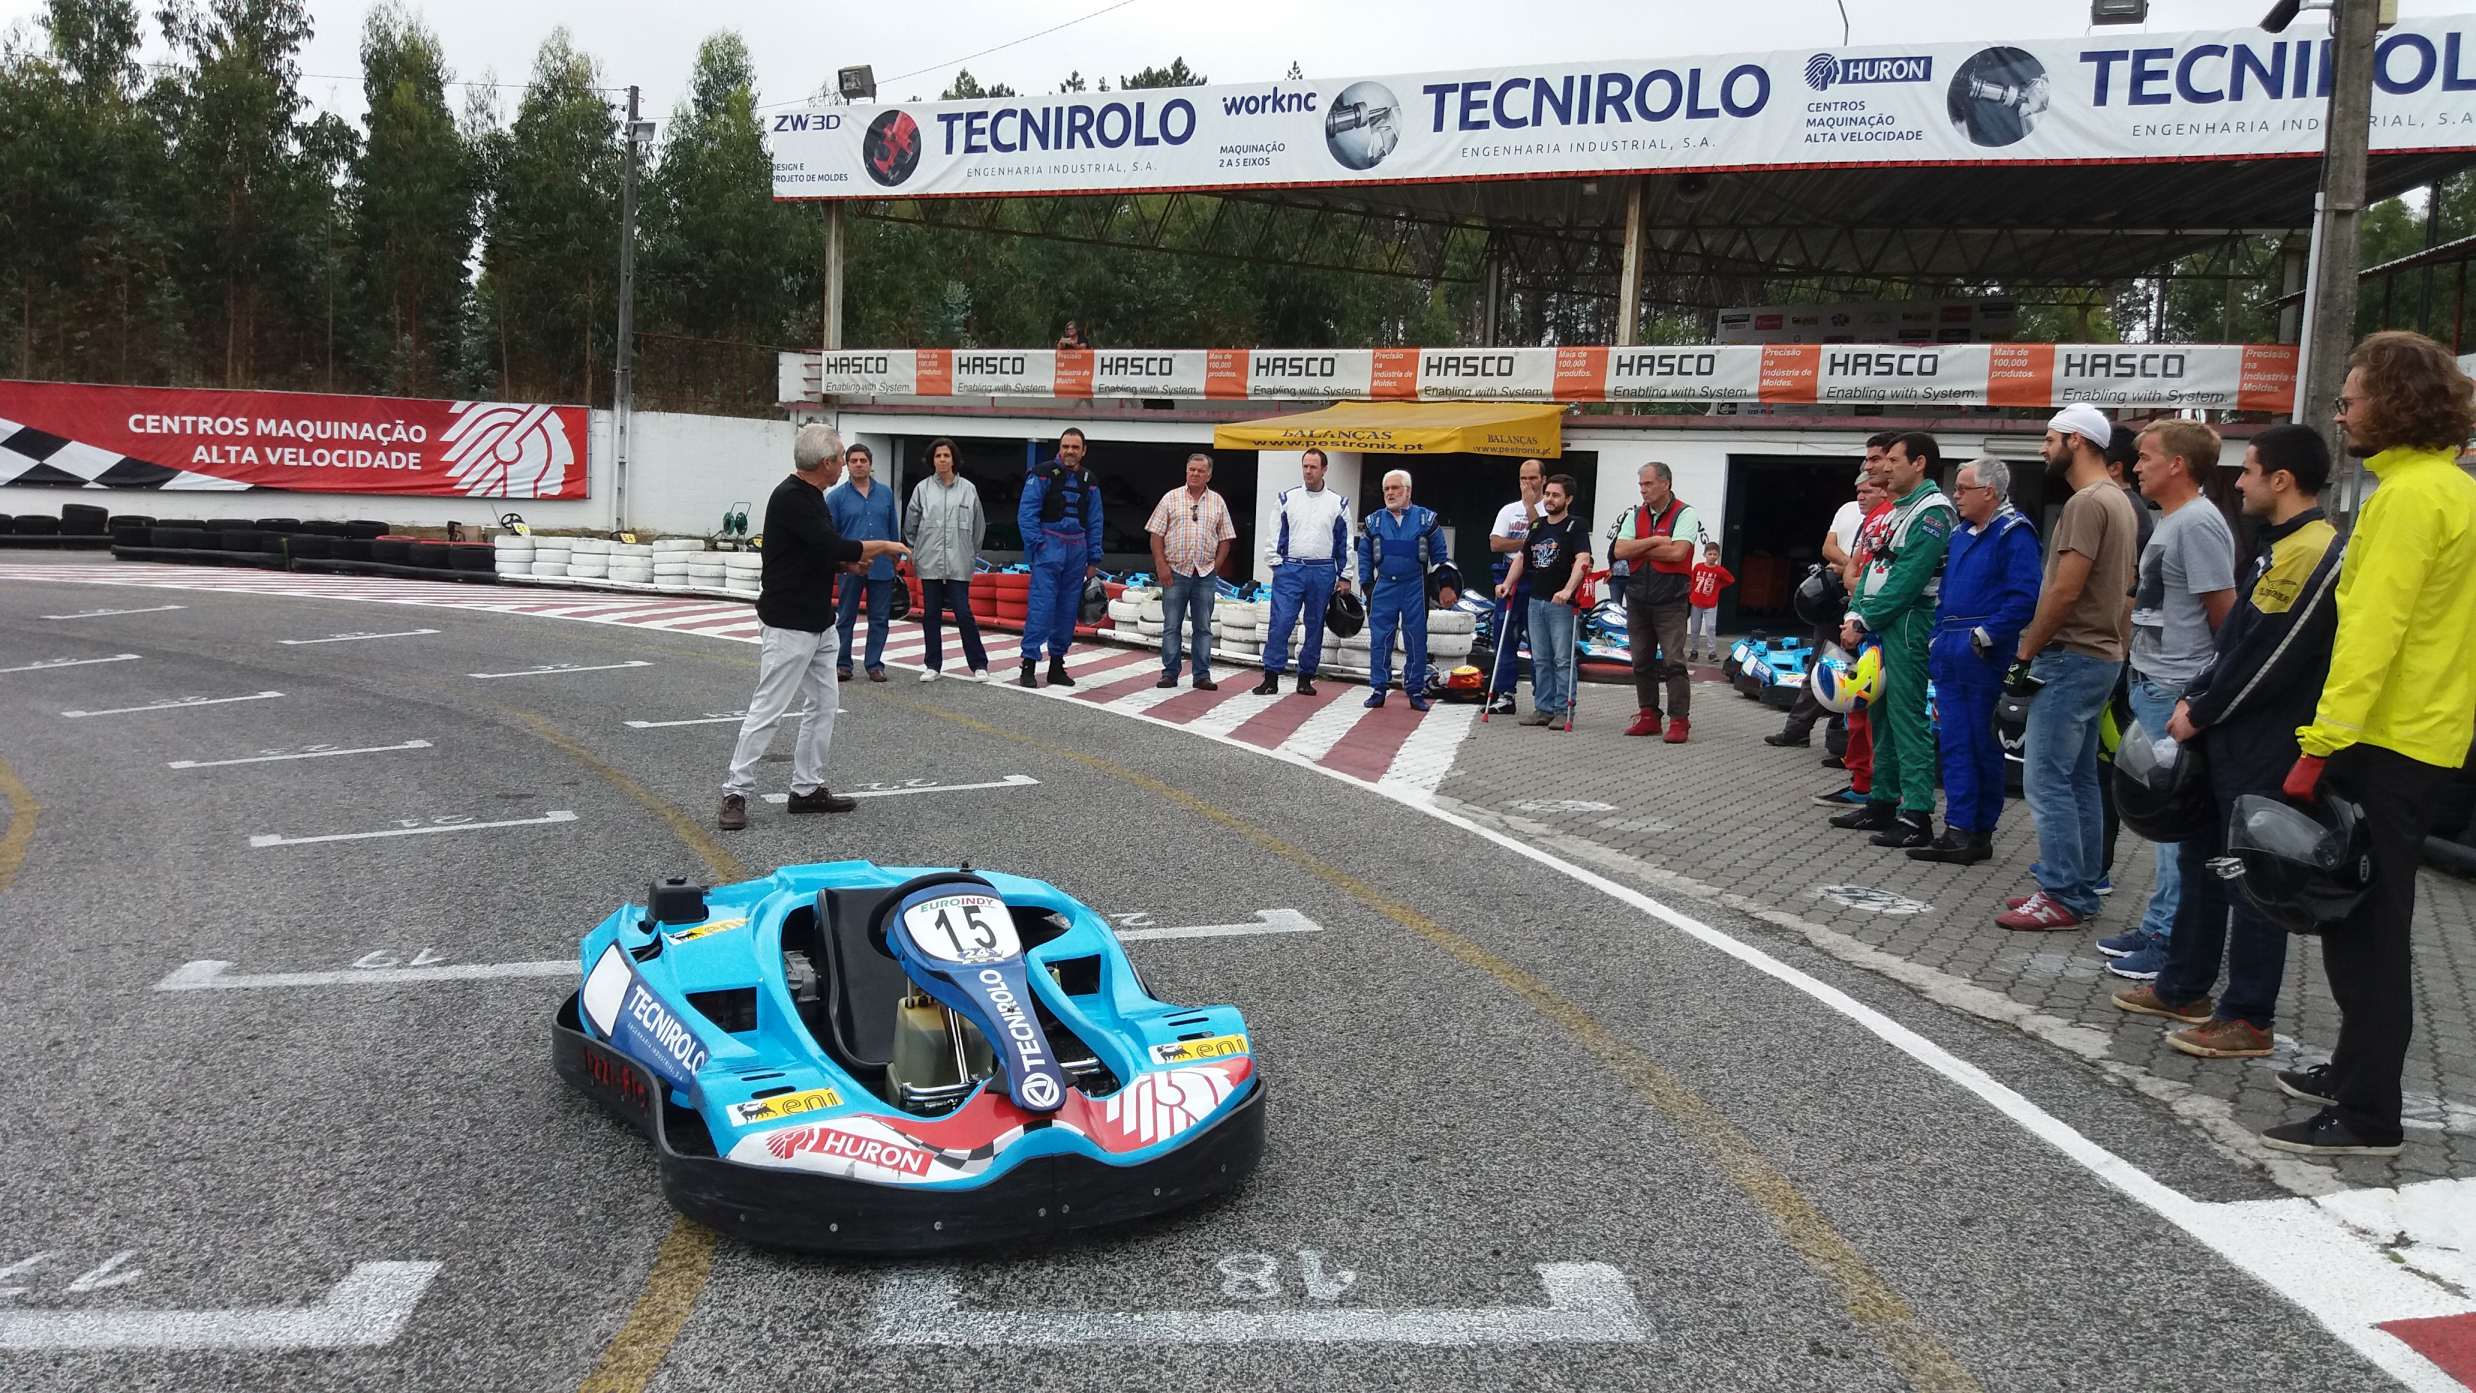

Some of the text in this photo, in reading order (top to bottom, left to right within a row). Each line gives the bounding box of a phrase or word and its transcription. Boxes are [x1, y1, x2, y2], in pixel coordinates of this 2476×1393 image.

[1849, 60, 1924, 81] HURON
[2079, 32, 2476, 107] TECNIOL
[1223, 87, 1317, 116] worknc
[1423, 64, 1771, 133] TECNIROLO
[1807, 101, 1866, 112] CENTROS
[774, 114, 841, 132] ZW3D
[937, 98, 1196, 155] TECNIROLO
[1806, 113, 1895, 129] MAQUINAÇÃO
[2131, 120, 2270, 137] ENGENHARIA
[1804, 130, 1923, 143] ALTA VELOCIDADE
[1219, 142, 1285, 155] MAQUINAÇÃO
[1461, 136, 1716, 158] ENGENHARIA INDUSTRIAL, S.A.
[967, 161, 1158, 177] ENGENHARIA INDUSTRIAL, S.A.
[1219, 157, 1270, 167] 2 A 5 EIXOS
[806, 174, 816, 182] DE
[817, 173, 848, 182] MOLDES
[1559, 350, 1587, 359] Mais de
[1765, 348, 1802, 357] Precisão
[1993, 347, 2029, 356] Mais de
[2245, 348, 2291, 360] Precisão
[826, 357, 887, 375] HASCO
[958, 357, 1024, 375] HASCO
[1100, 357, 1173, 376] HASCO
[1255, 357, 1335, 377] HASCO
[1425, 356, 1514, 377] HASCO
[1616, 354, 1715, 376] HASCO
[1801, 368, 1812, 376] de
[1828, 353, 1938, 377] HASCO
[2064, 353, 2185, 379] HASCO
[2245, 362, 2257, 370] na
[826, 382, 860, 394] Enabling
[861, 383, 877, 393] with
[957, 383, 992, 395] Enabling
[994, 384, 1012, 394] with
[1098, 384, 1138, 396] Enabling
[1140, 385, 1159, 395] with
[1253, 385, 1296, 397] Enabling
[1299, 387, 1319, 396] with
[1424, 386, 1472, 398] Enabling
[1474, 386, 1498, 397] with
[1614, 386, 1667, 399] Enabling
[1671, 386, 1697, 398] with
[1826, 386, 1979, 401] Enabling with System.
[2062, 388, 2229, 404] Enabling with System.
[128, 413, 428, 443] CENTROS MAQUINAÇÃO
[1252, 440, 1424, 452] www.pestronix.pt
[192, 445, 422, 471] ALTA VELOCIDADE
[920, 897, 993, 912] EUROINDY
[934, 905, 997, 953] 15
[979, 969, 1046, 1072] TECNIROLO
[628, 984, 705, 1076] TECNIROLO
[1196, 1034, 1246, 1058] eni
[782, 1087, 838, 1115] eni
[823, 1132, 924, 1171] HURON
